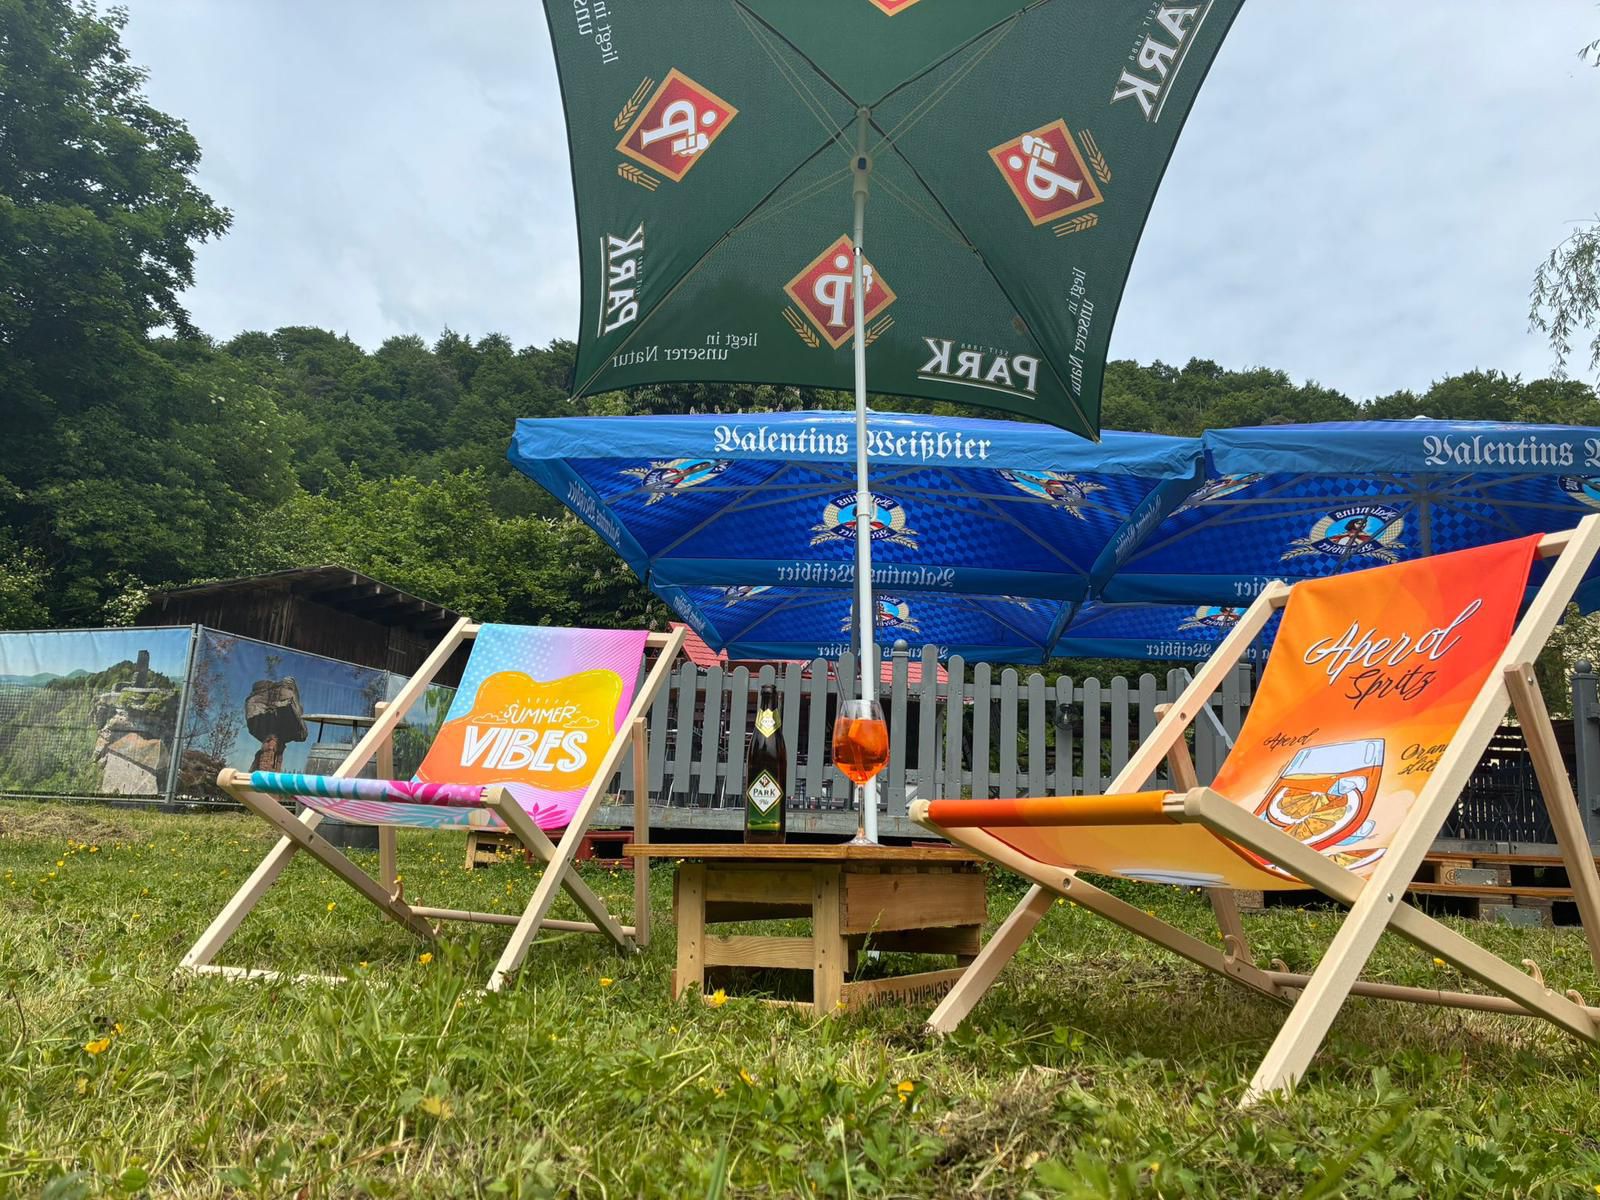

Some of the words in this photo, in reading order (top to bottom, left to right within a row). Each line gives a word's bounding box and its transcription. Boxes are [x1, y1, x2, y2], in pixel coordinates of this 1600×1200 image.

[713, 425, 849, 456] Valentins
[1422, 435, 1574, 467] Valentins
[1303, 598, 1482, 686] Aperol
[1344, 664, 1437, 711] Spritz
[503, 702, 577, 725] SUMMER
[460, 725, 589, 773] VIBES
[1263, 728, 1320, 749] Aperol
[753, 788, 776, 796] PARK
